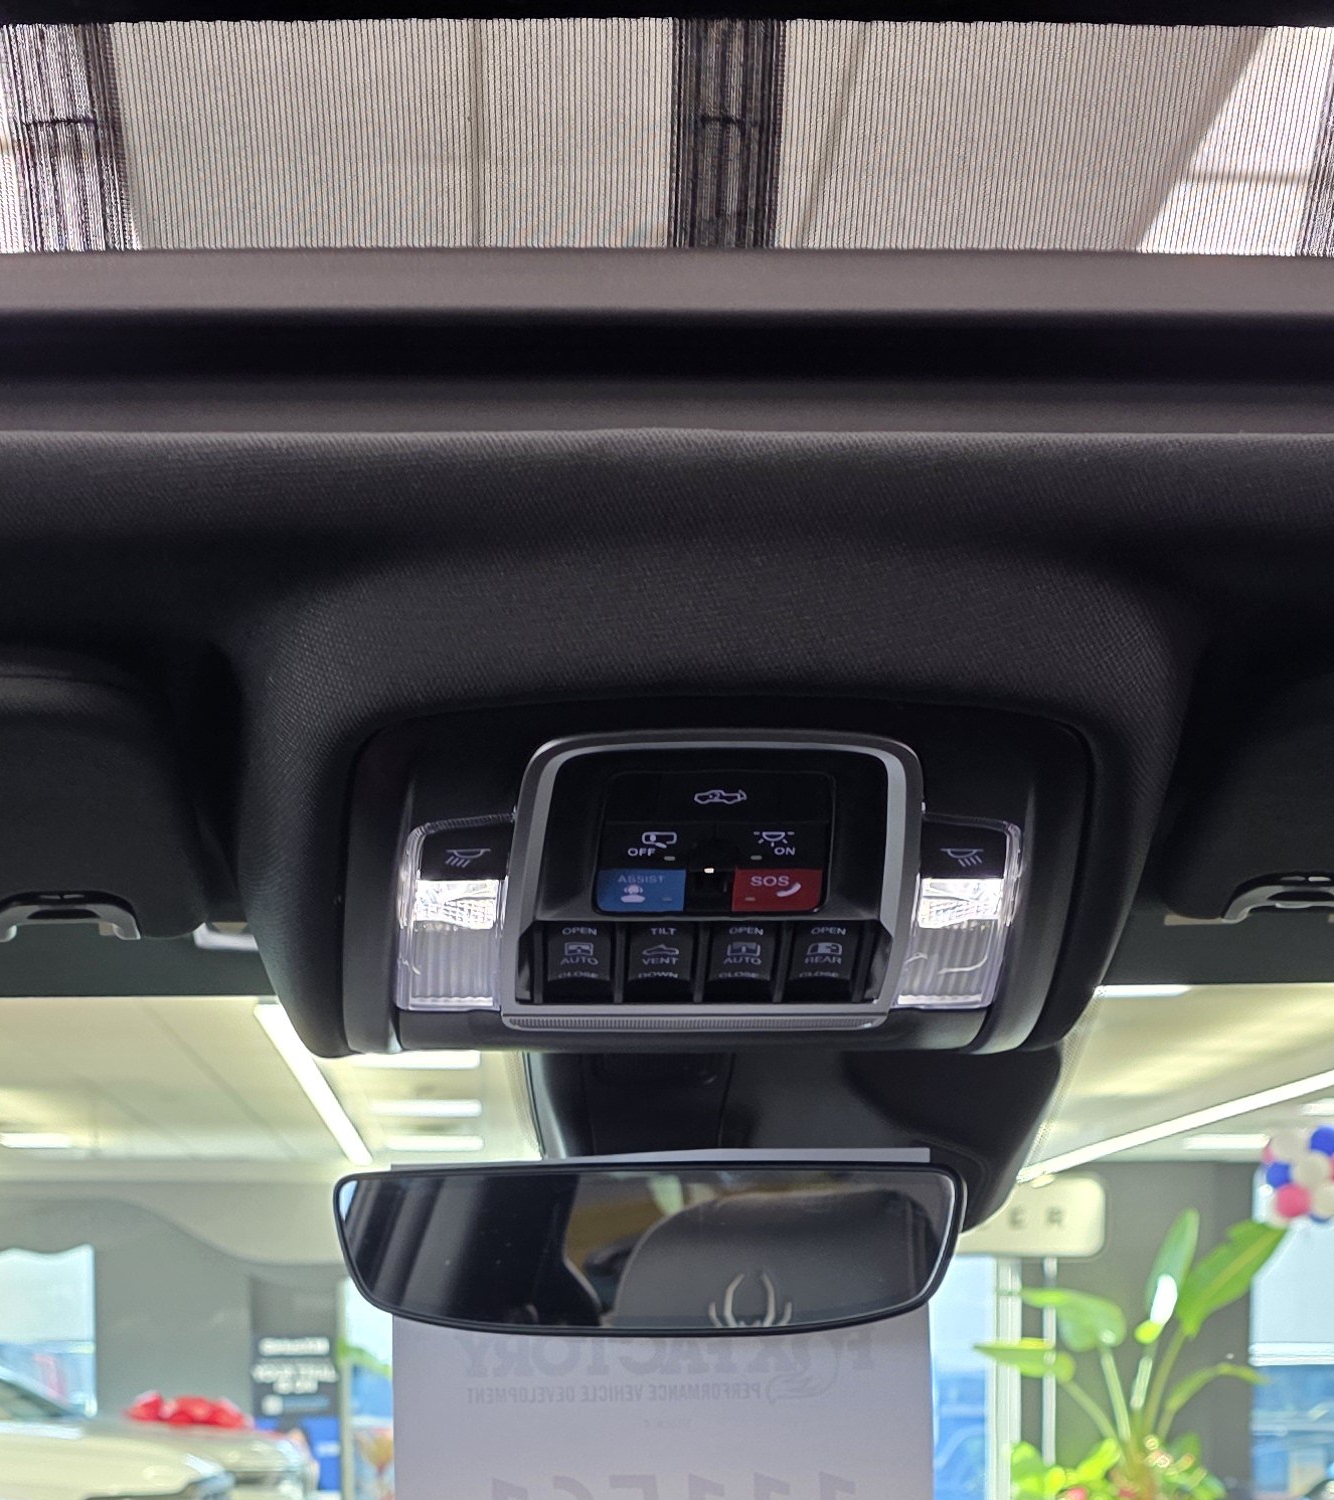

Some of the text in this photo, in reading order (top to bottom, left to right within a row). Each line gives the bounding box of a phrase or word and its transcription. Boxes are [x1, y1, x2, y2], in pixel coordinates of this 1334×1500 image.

[627, 847, 657, 857] OFF
[773, 846, 796, 856] ON
[617, 874, 665, 884] ASSIST
[750, 875, 790, 887] SOS
[561, 926, 598, 936] OPEN
[650, 927, 677, 936] TILT
[728, 926, 764, 936] OPEN
[810, 926, 846, 936] OPEN
[559, 956, 599, 965] AUTO
[641, 956, 679, 966] VENT
[722, 956, 762, 966] AUTO
[804, 955, 842, 965] REAR
